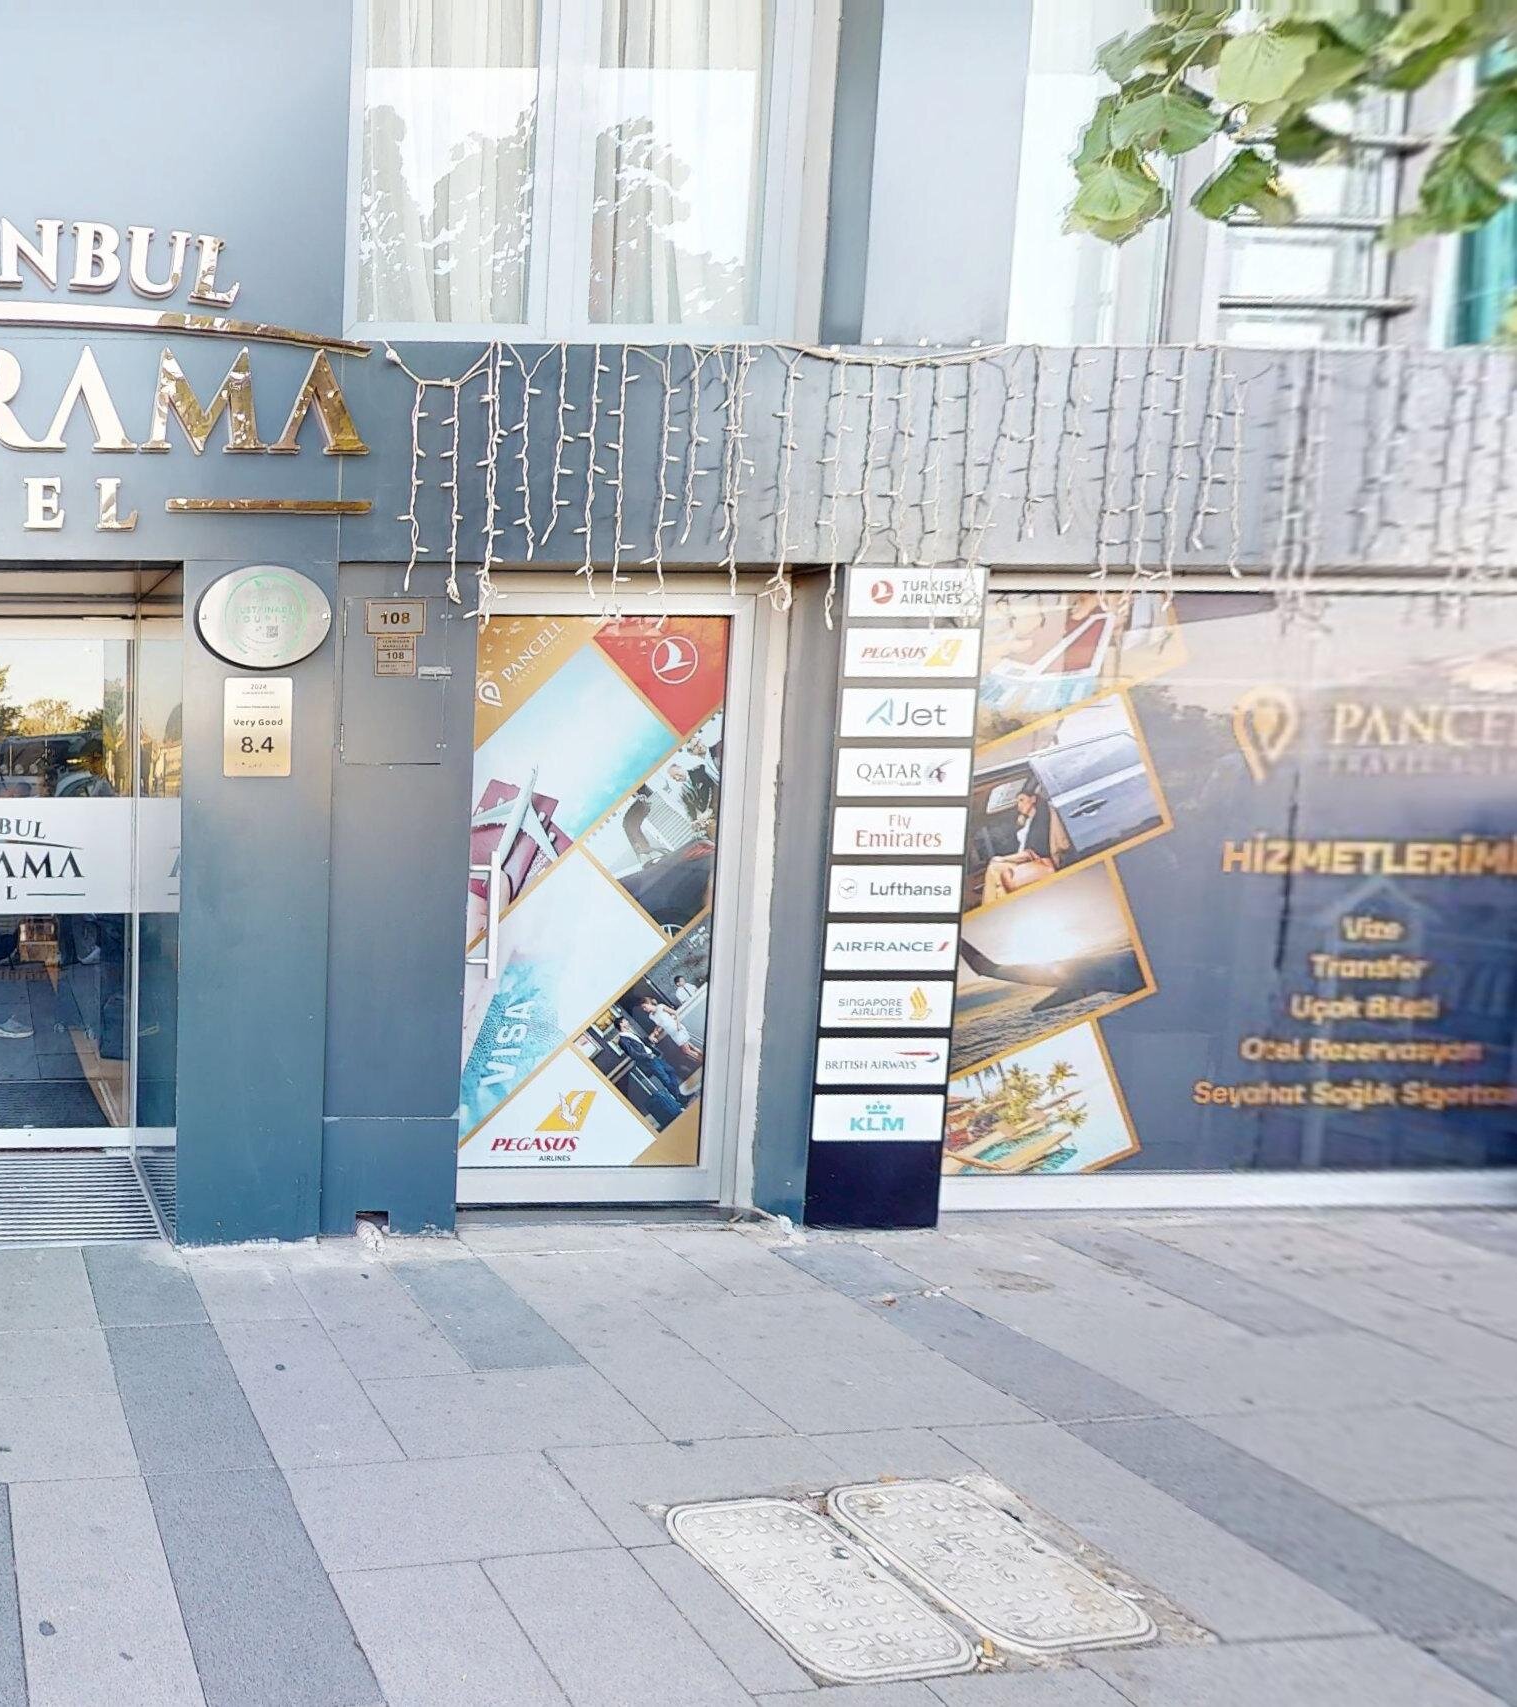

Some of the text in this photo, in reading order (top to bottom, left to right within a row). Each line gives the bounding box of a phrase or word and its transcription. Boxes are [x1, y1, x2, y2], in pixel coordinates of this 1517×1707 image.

[902, 580, 963, 592] TURKISH
[900, 593, 963, 605] AIRLINES
[381, 611, 410, 625] 108
[387, 651, 405, 660] 108
[501, 621, 565, 682] PANCELL
[861, 646, 928, 659] PEGASUS
[233, 717, 283, 728] Very Good
[1330, 702, 1517, 746] PANCE
[241, 736, 275, 754] 8.4
[856, 762, 922, 782] QATAR
[888, 813, 913, 829] Fly
[854, 829, 943, 848] Emirates
[870, 881, 953, 897] Lufthansa
[1309, 952, 1430, 980] Transfer
[838, 998, 903, 1007] SINGAPORE
[850, 1007, 904, 1017] AIRLINES
[479, 1000, 534, 1088] VISA
[825, 1059, 917, 1070] BRITISH AIRWAYS
[1192, 1079, 1306, 1110] Seyahat
[849, 1116, 905, 1132] KLM
[490, 1135, 580, 1152] PEGASUS
[538, 1154, 571, 1162] AIRLINES
